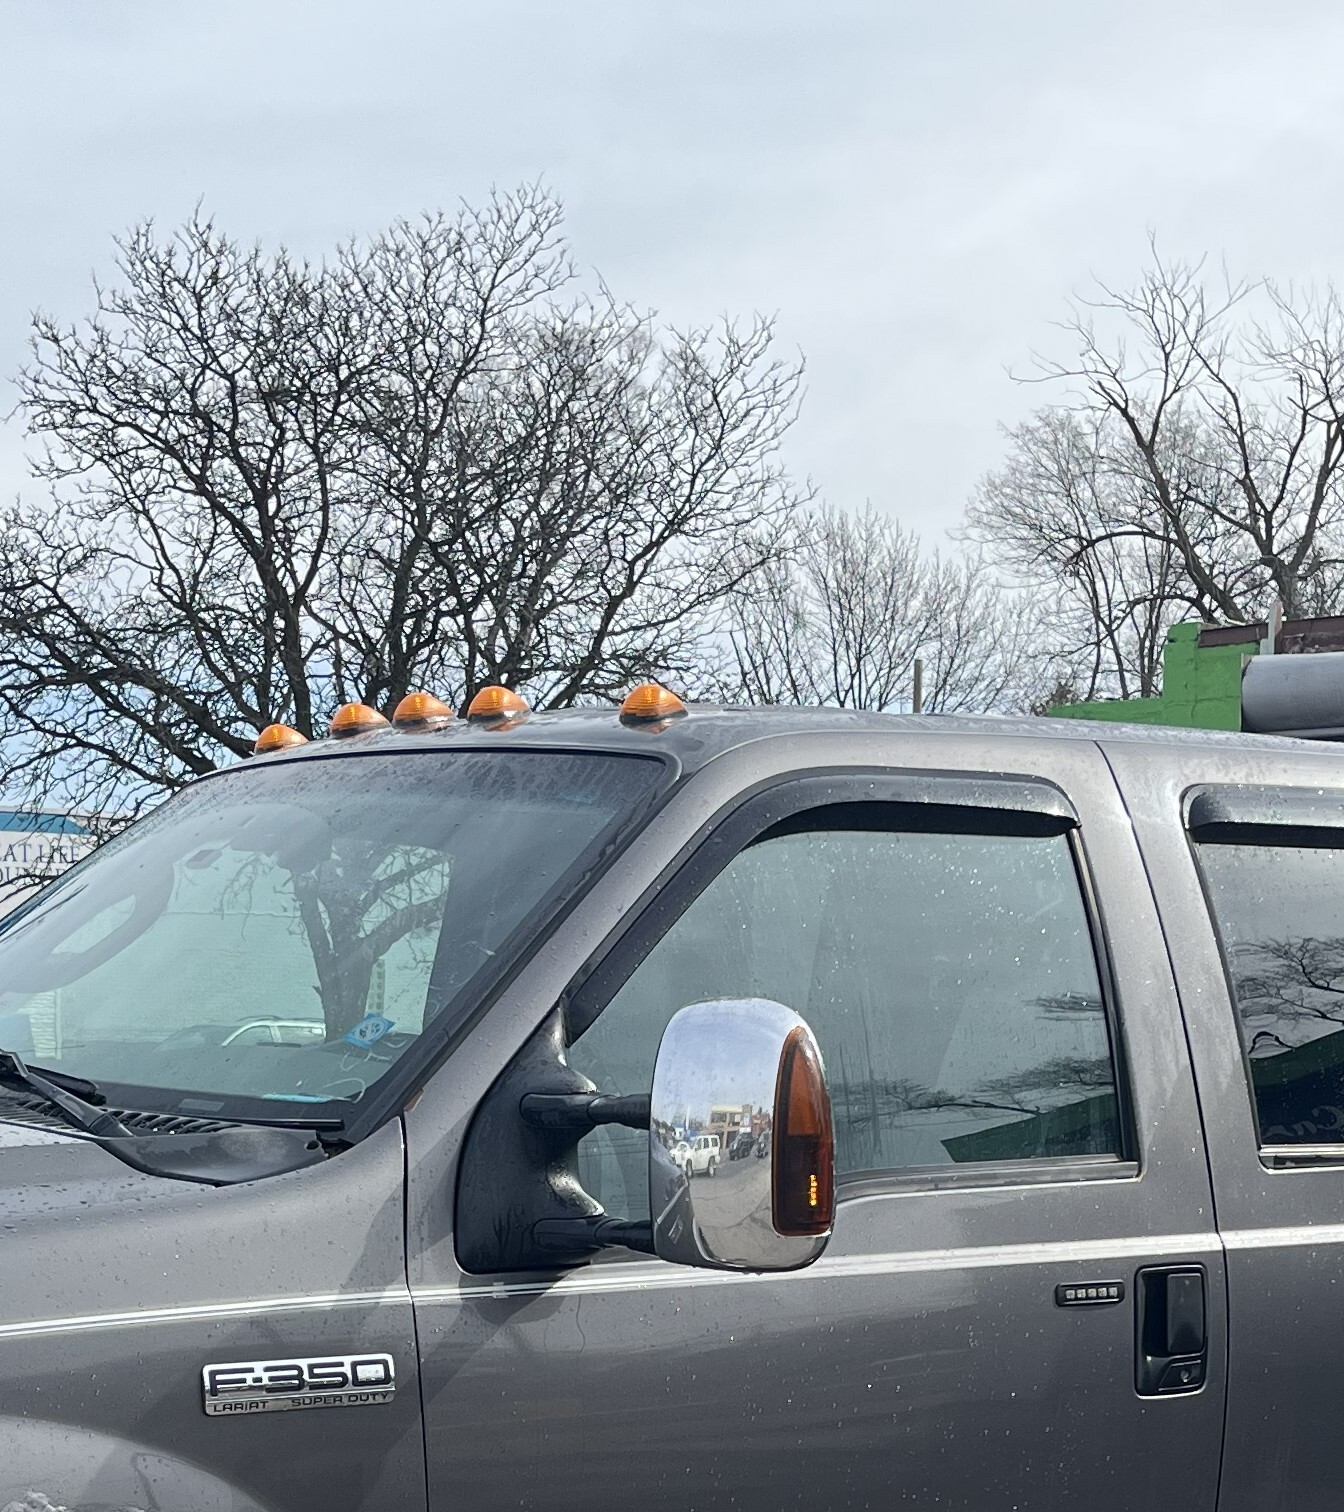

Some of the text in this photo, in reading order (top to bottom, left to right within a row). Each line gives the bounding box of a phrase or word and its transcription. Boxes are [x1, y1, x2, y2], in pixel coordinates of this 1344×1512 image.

[212, 1391, 390, 1414] LARIAT SUPER DUTY
